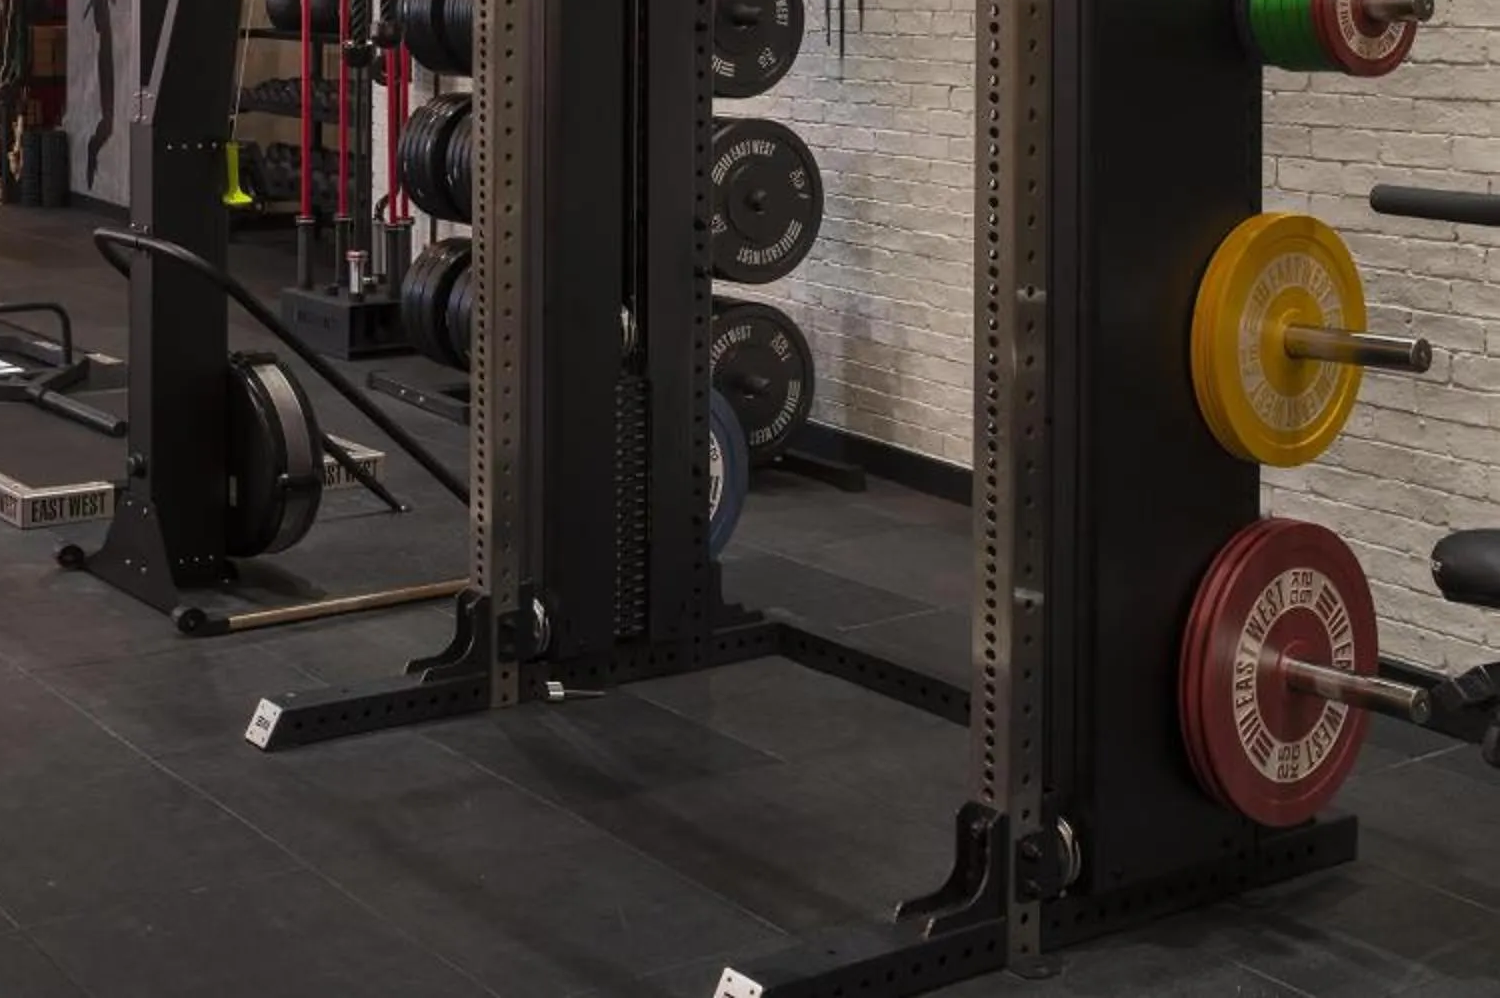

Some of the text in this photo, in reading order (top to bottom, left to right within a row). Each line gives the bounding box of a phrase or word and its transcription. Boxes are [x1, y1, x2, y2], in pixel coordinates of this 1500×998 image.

[730, 139, 776, 161] EAST WEST
[31, 491, 106, 523] EAST WEST
[1235, 579, 1285, 709] EAST WEST
[1306, 704, 1344, 771] WEST
